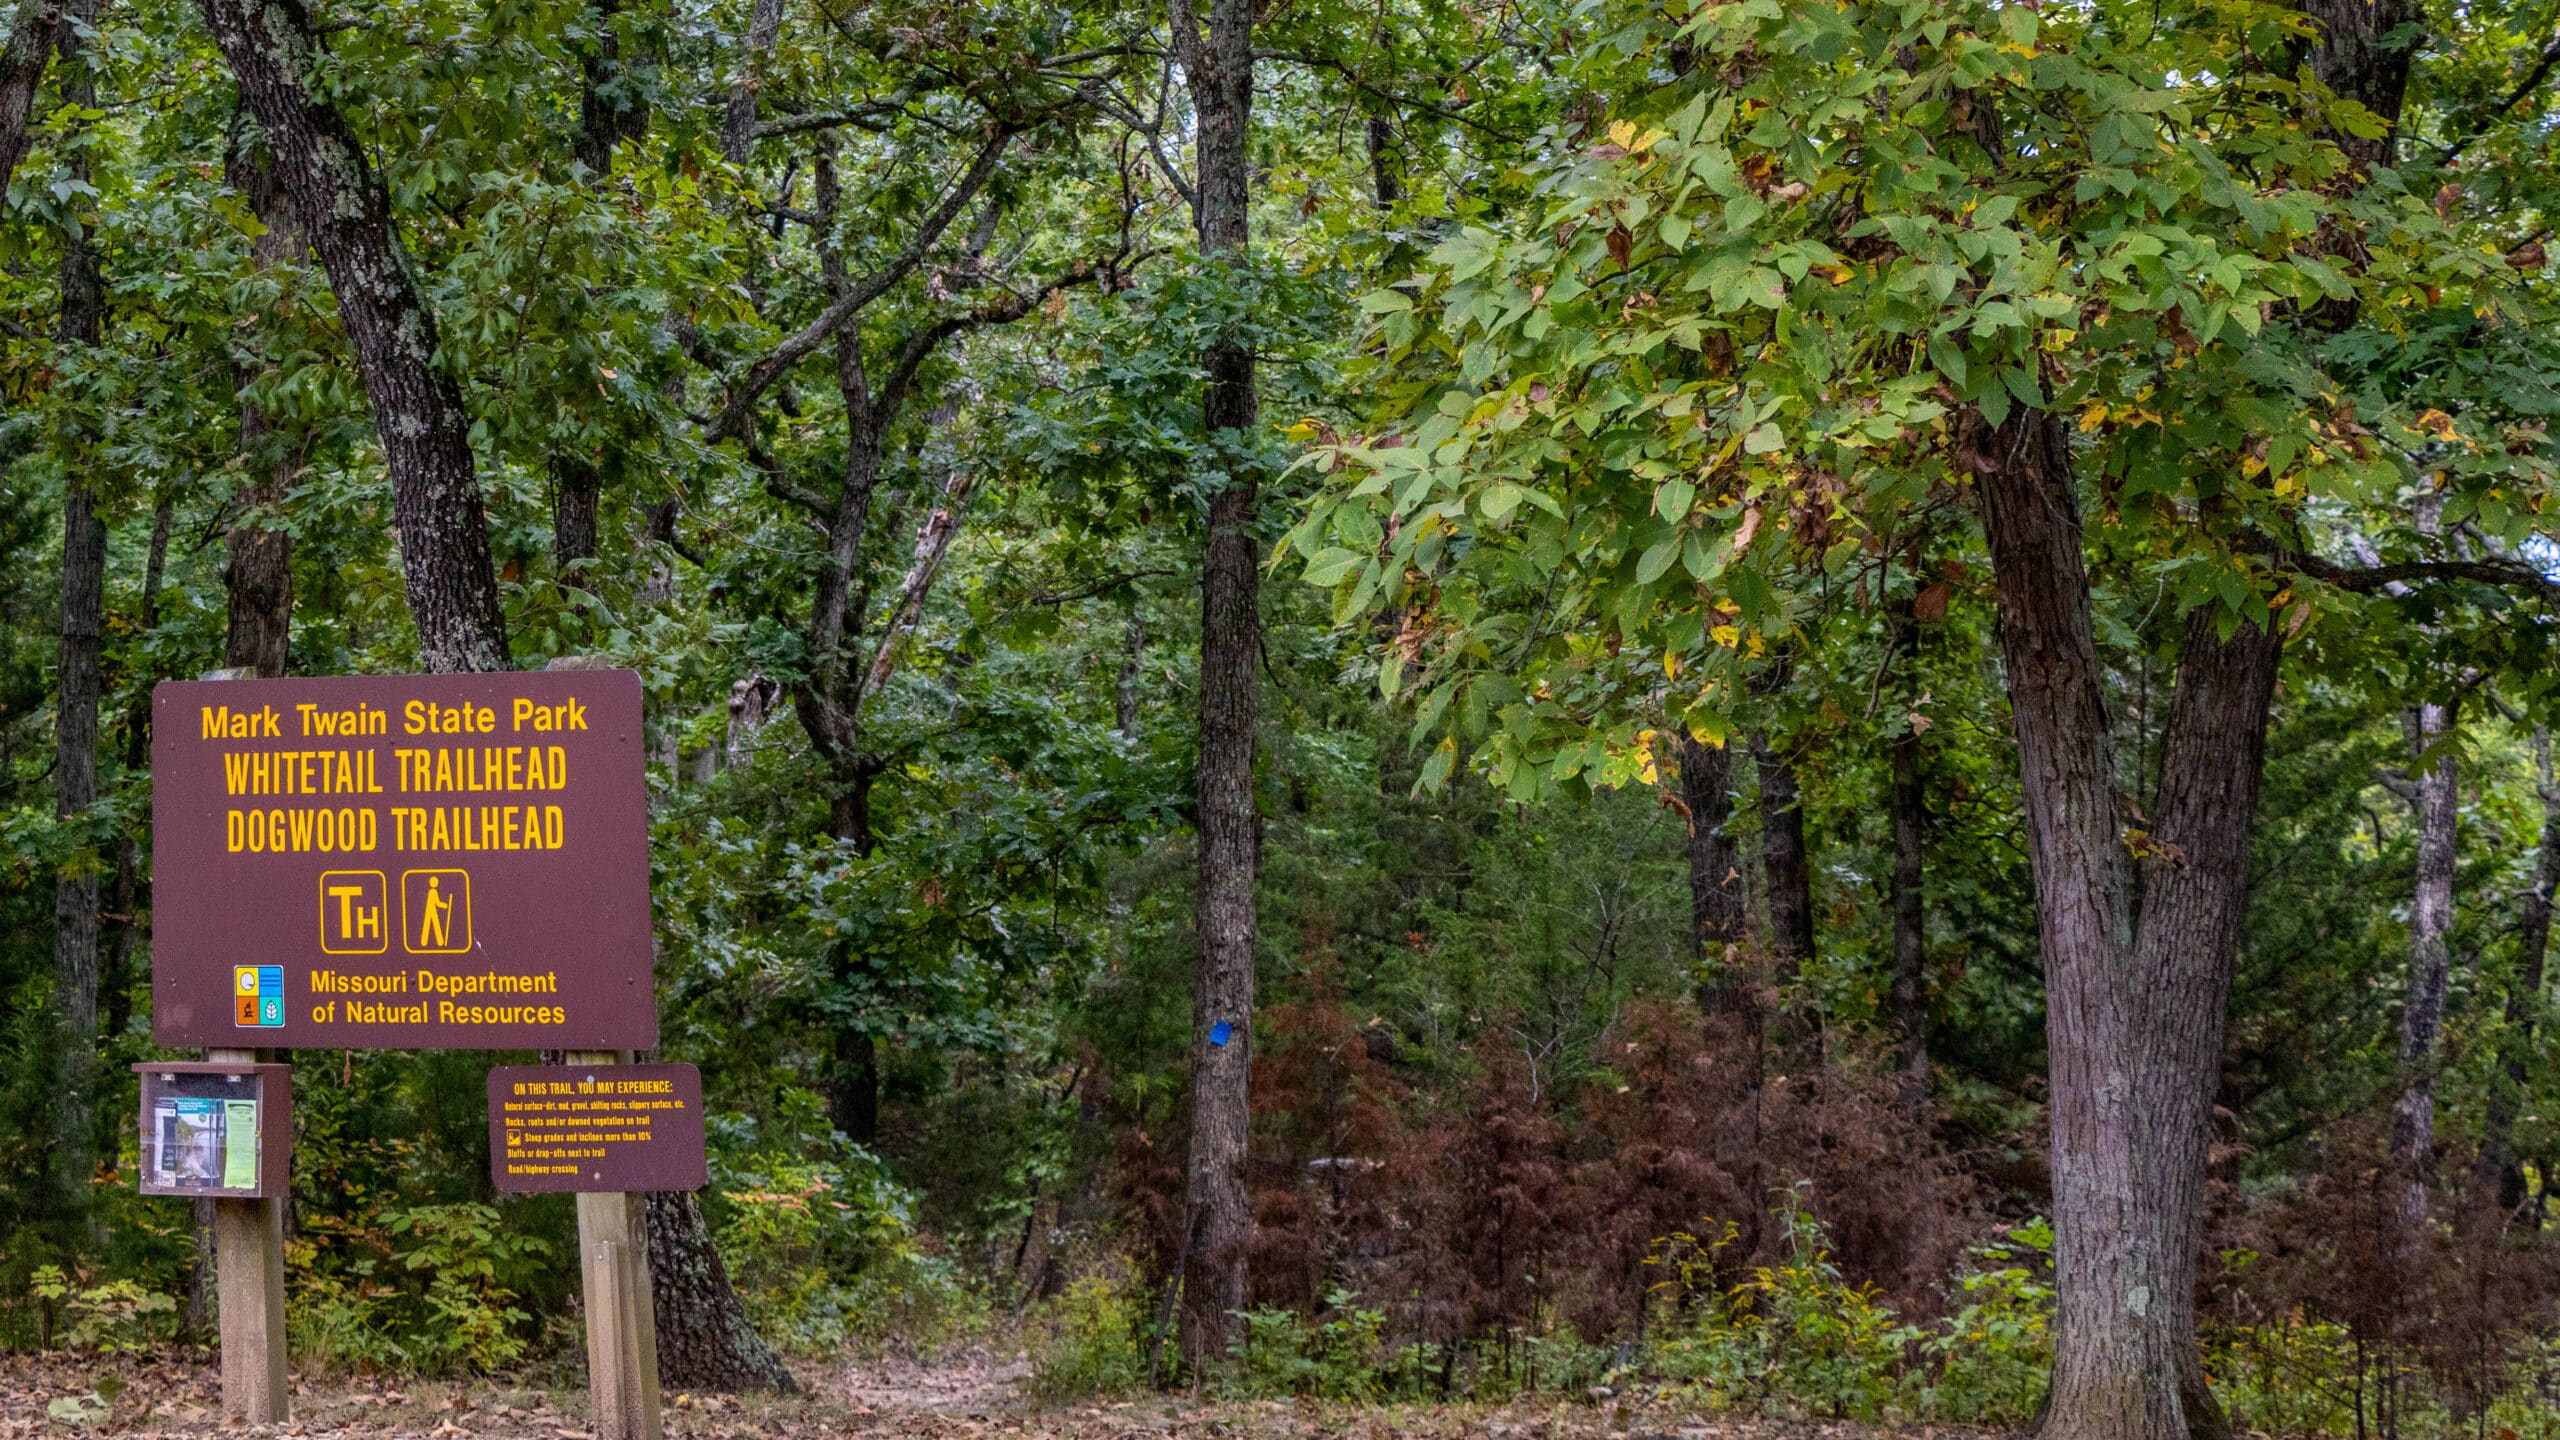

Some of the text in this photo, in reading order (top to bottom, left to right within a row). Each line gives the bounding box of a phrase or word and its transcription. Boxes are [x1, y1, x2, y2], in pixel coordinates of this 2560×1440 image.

[202, 697, 587, 738] Mark Twain State Park
[224, 746, 566, 795] WHITETAIL TRAILHEAD
[228, 806, 563, 852] DOGWOOD TRAILHEAD
[311, 970, 556, 997] Missouri Department
[312, 1001, 565, 1024] of Natural Resources
[514, 1083, 526, 1095] ON
[528, 1082, 547, 1095] THIS
[578, 1082, 594, 1094] YOU
[597, 1082, 615, 1094] MAY
[617, 1081, 673, 1094] EXPERIENCE:
[504, 1102, 523, 1111] Natural
[629, 1101, 650, 1110] slippery
[528, 1118, 544, 1126] roots
[567, 1117, 591, 1126] downed
[592, 1117, 625, 1127] vegetation
[626, 1117, 635, 1125] on
[636, 1116, 650, 1125] trail
[524, 1133, 542, 1143] Steep
[543, 1133, 564, 1143] grades
[566, 1133, 577, 1142] and
[578, 1133, 604, 1142] inclines
[622, 1133, 636, 1141] than
[638, 1132, 651, 1141] 10%
[507, 1148, 605, 1159] Bluffs or drop-offs next to trail
[508, 1164, 578, 1175] Road/highway crossing
